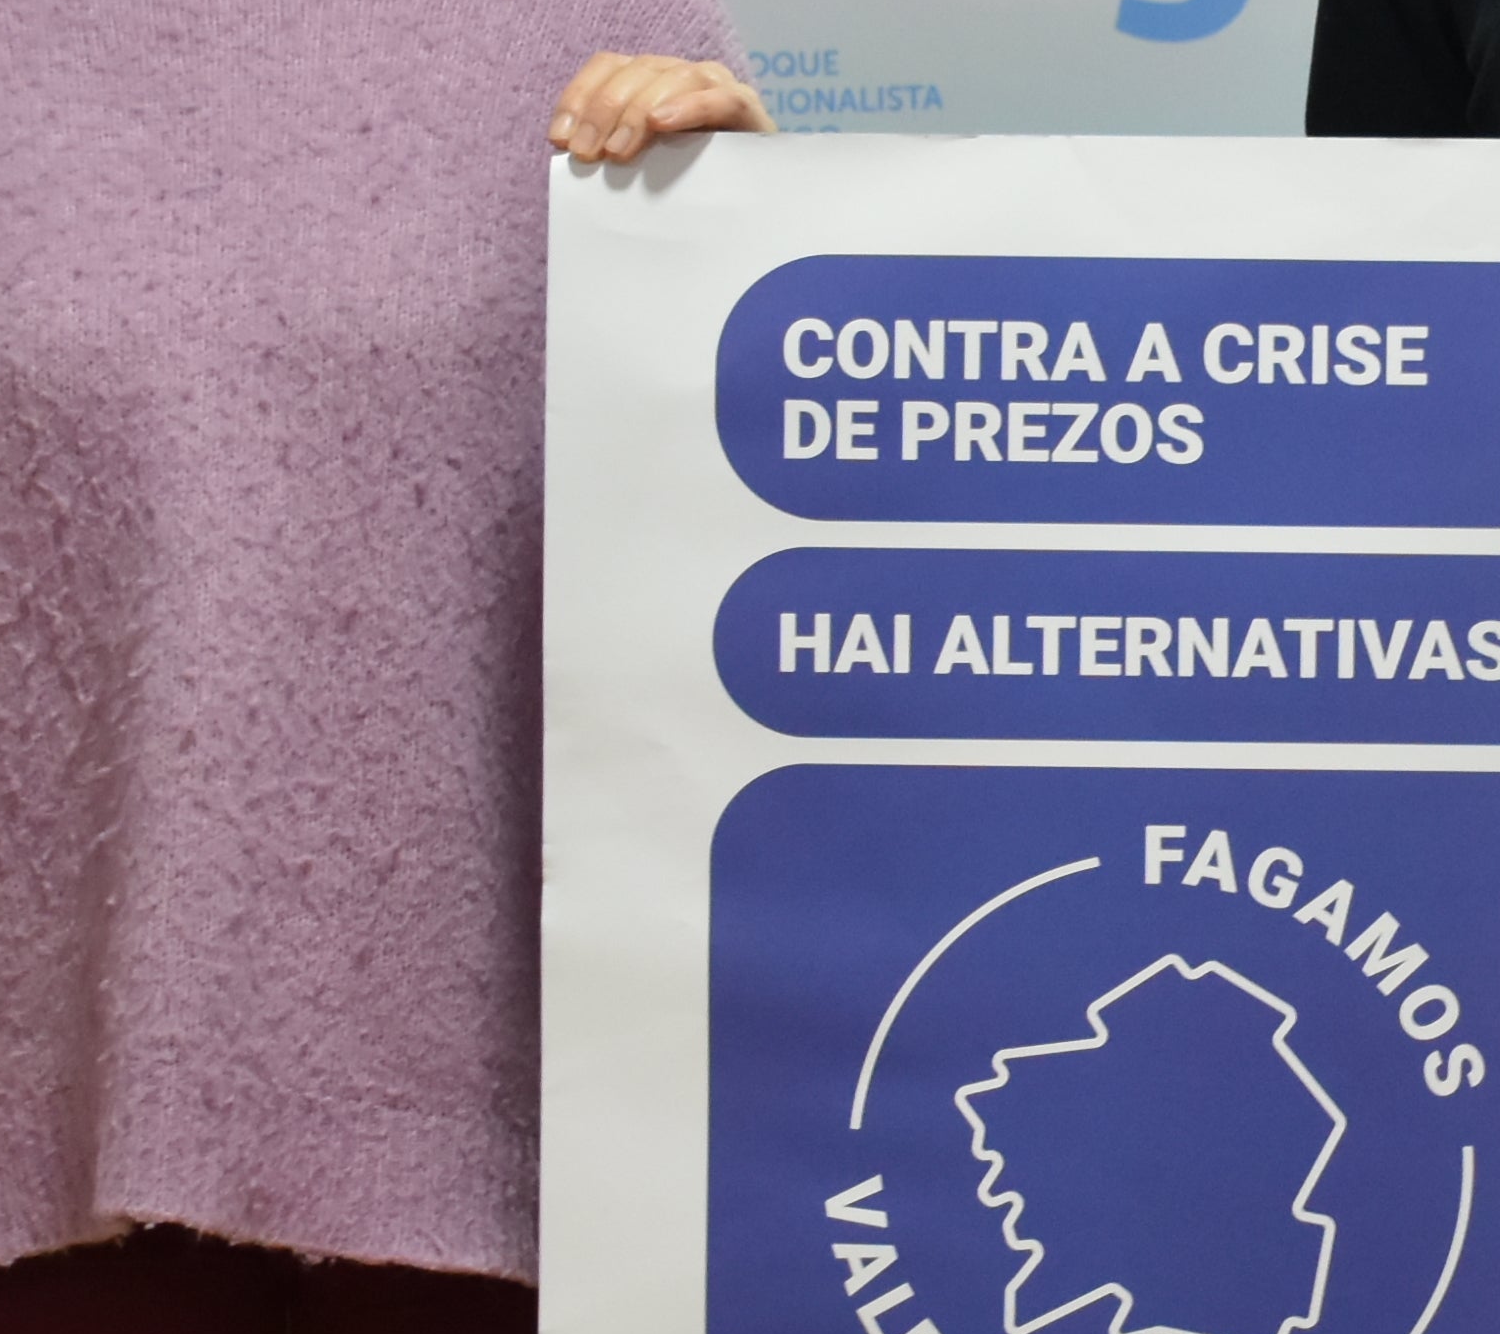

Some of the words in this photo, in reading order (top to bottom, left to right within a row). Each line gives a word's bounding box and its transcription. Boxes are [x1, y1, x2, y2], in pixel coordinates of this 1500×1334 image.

[749, 50, 840, 79] OQUE
[782, 316, 1107, 383] CONTRA
[1124, 322, 1182, 383] A
[1203, 322, 1430, 386] CRISE
[783, 399, 879, 461] DE
[901, 400, 1205, 465] PREZOS
[779, 612, 911, 674] HAI
[1144, 824, 1486, 1098] FAGAMOS
